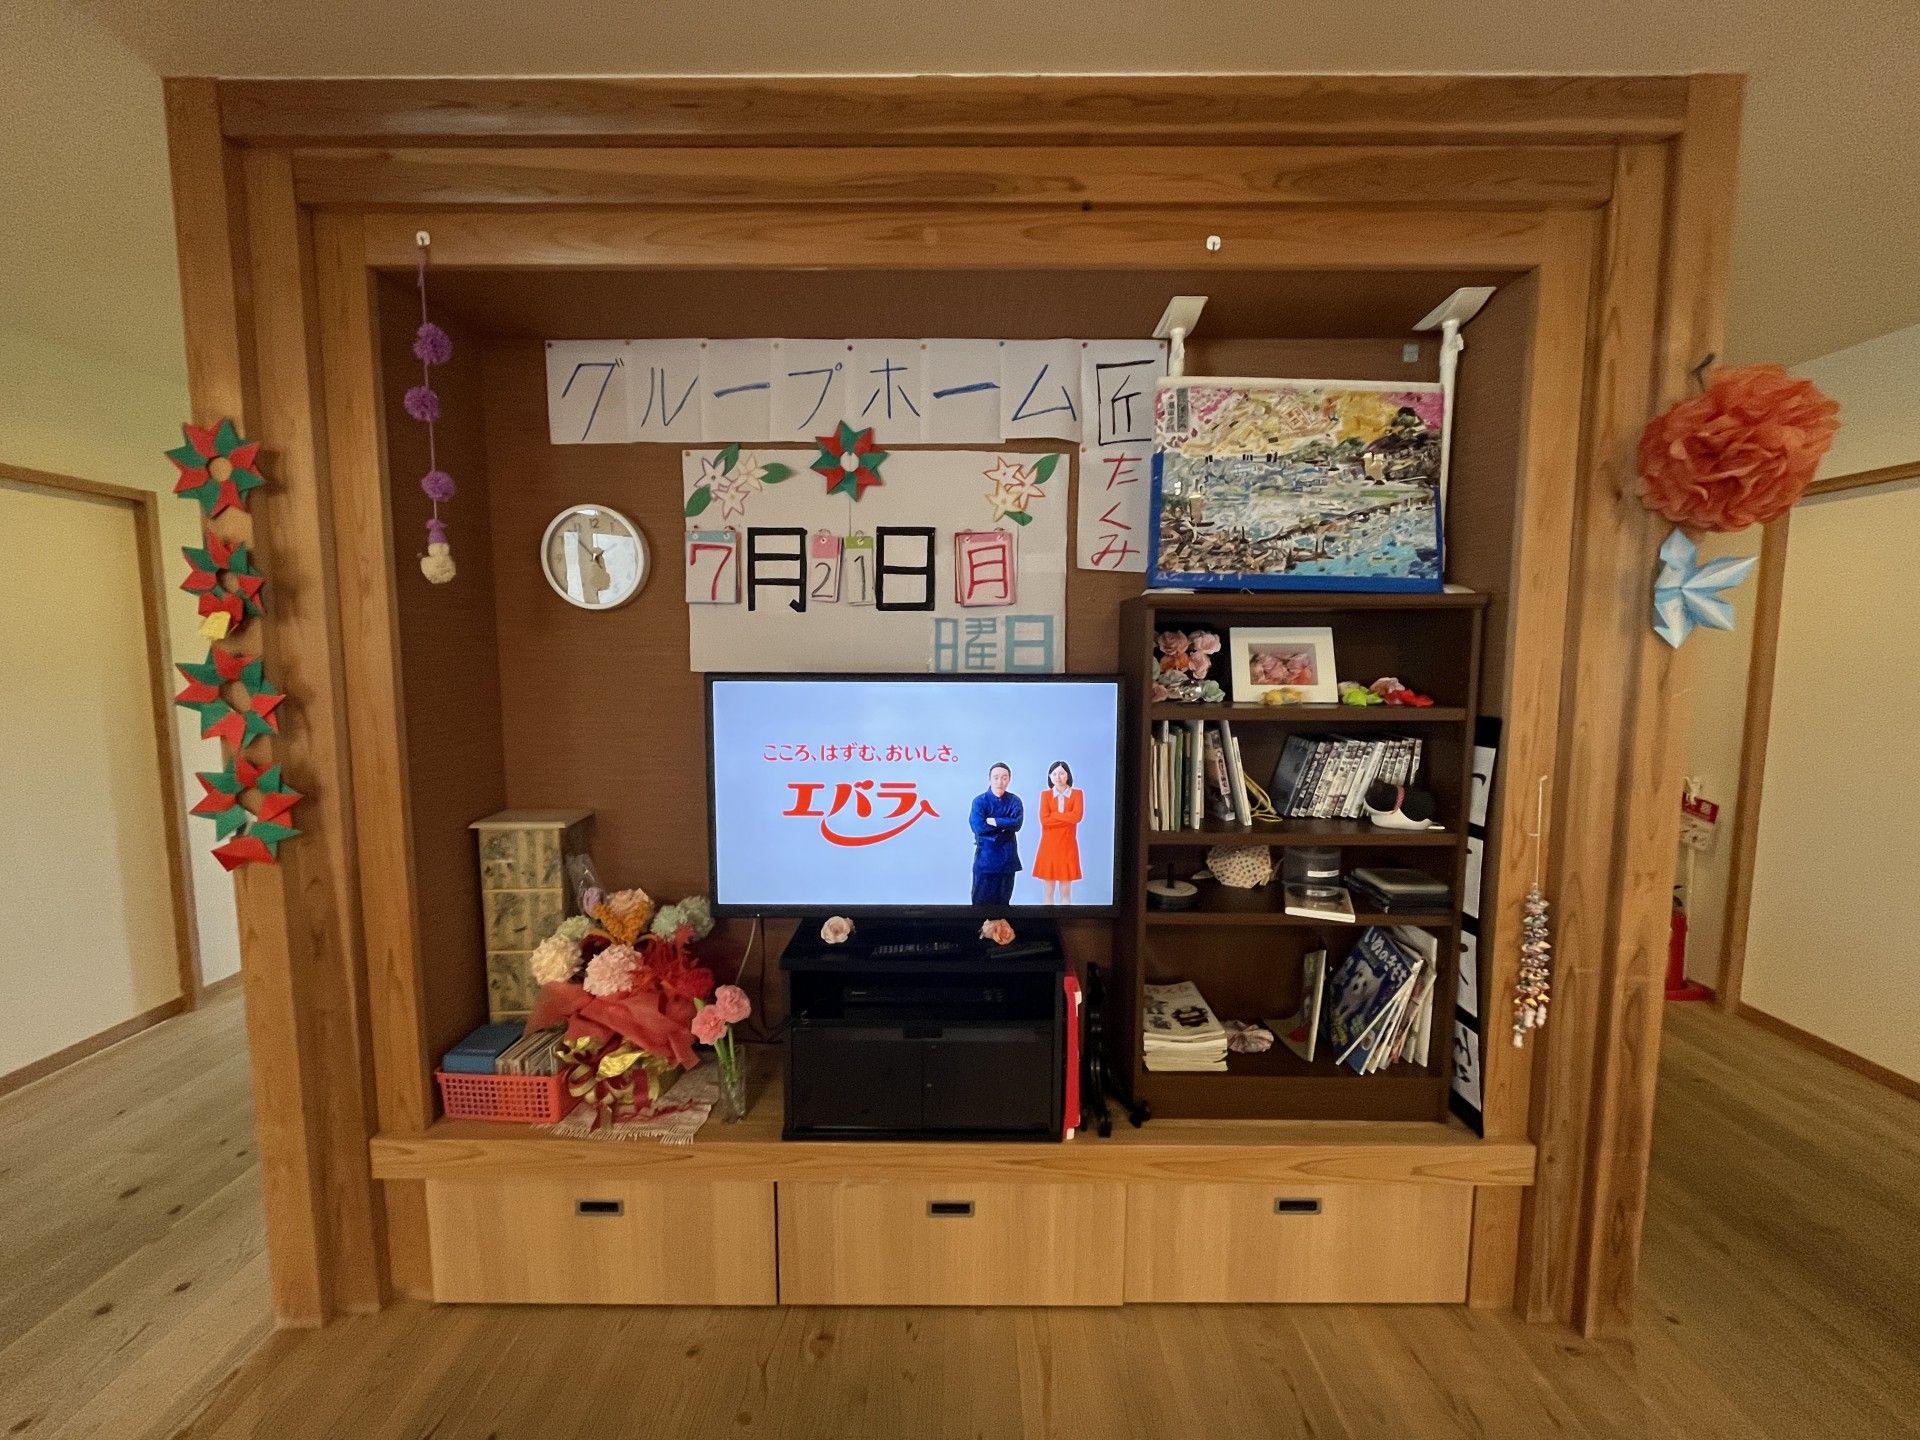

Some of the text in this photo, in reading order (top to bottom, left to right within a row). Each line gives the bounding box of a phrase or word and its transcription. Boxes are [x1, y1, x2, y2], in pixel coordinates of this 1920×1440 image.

[588, 518, 600, 529] 12
[1091, 452, 1142, 569] たくみ
[935, 614, 1054, 674] 曜日
[783, 779, 920, 819] エバラ
